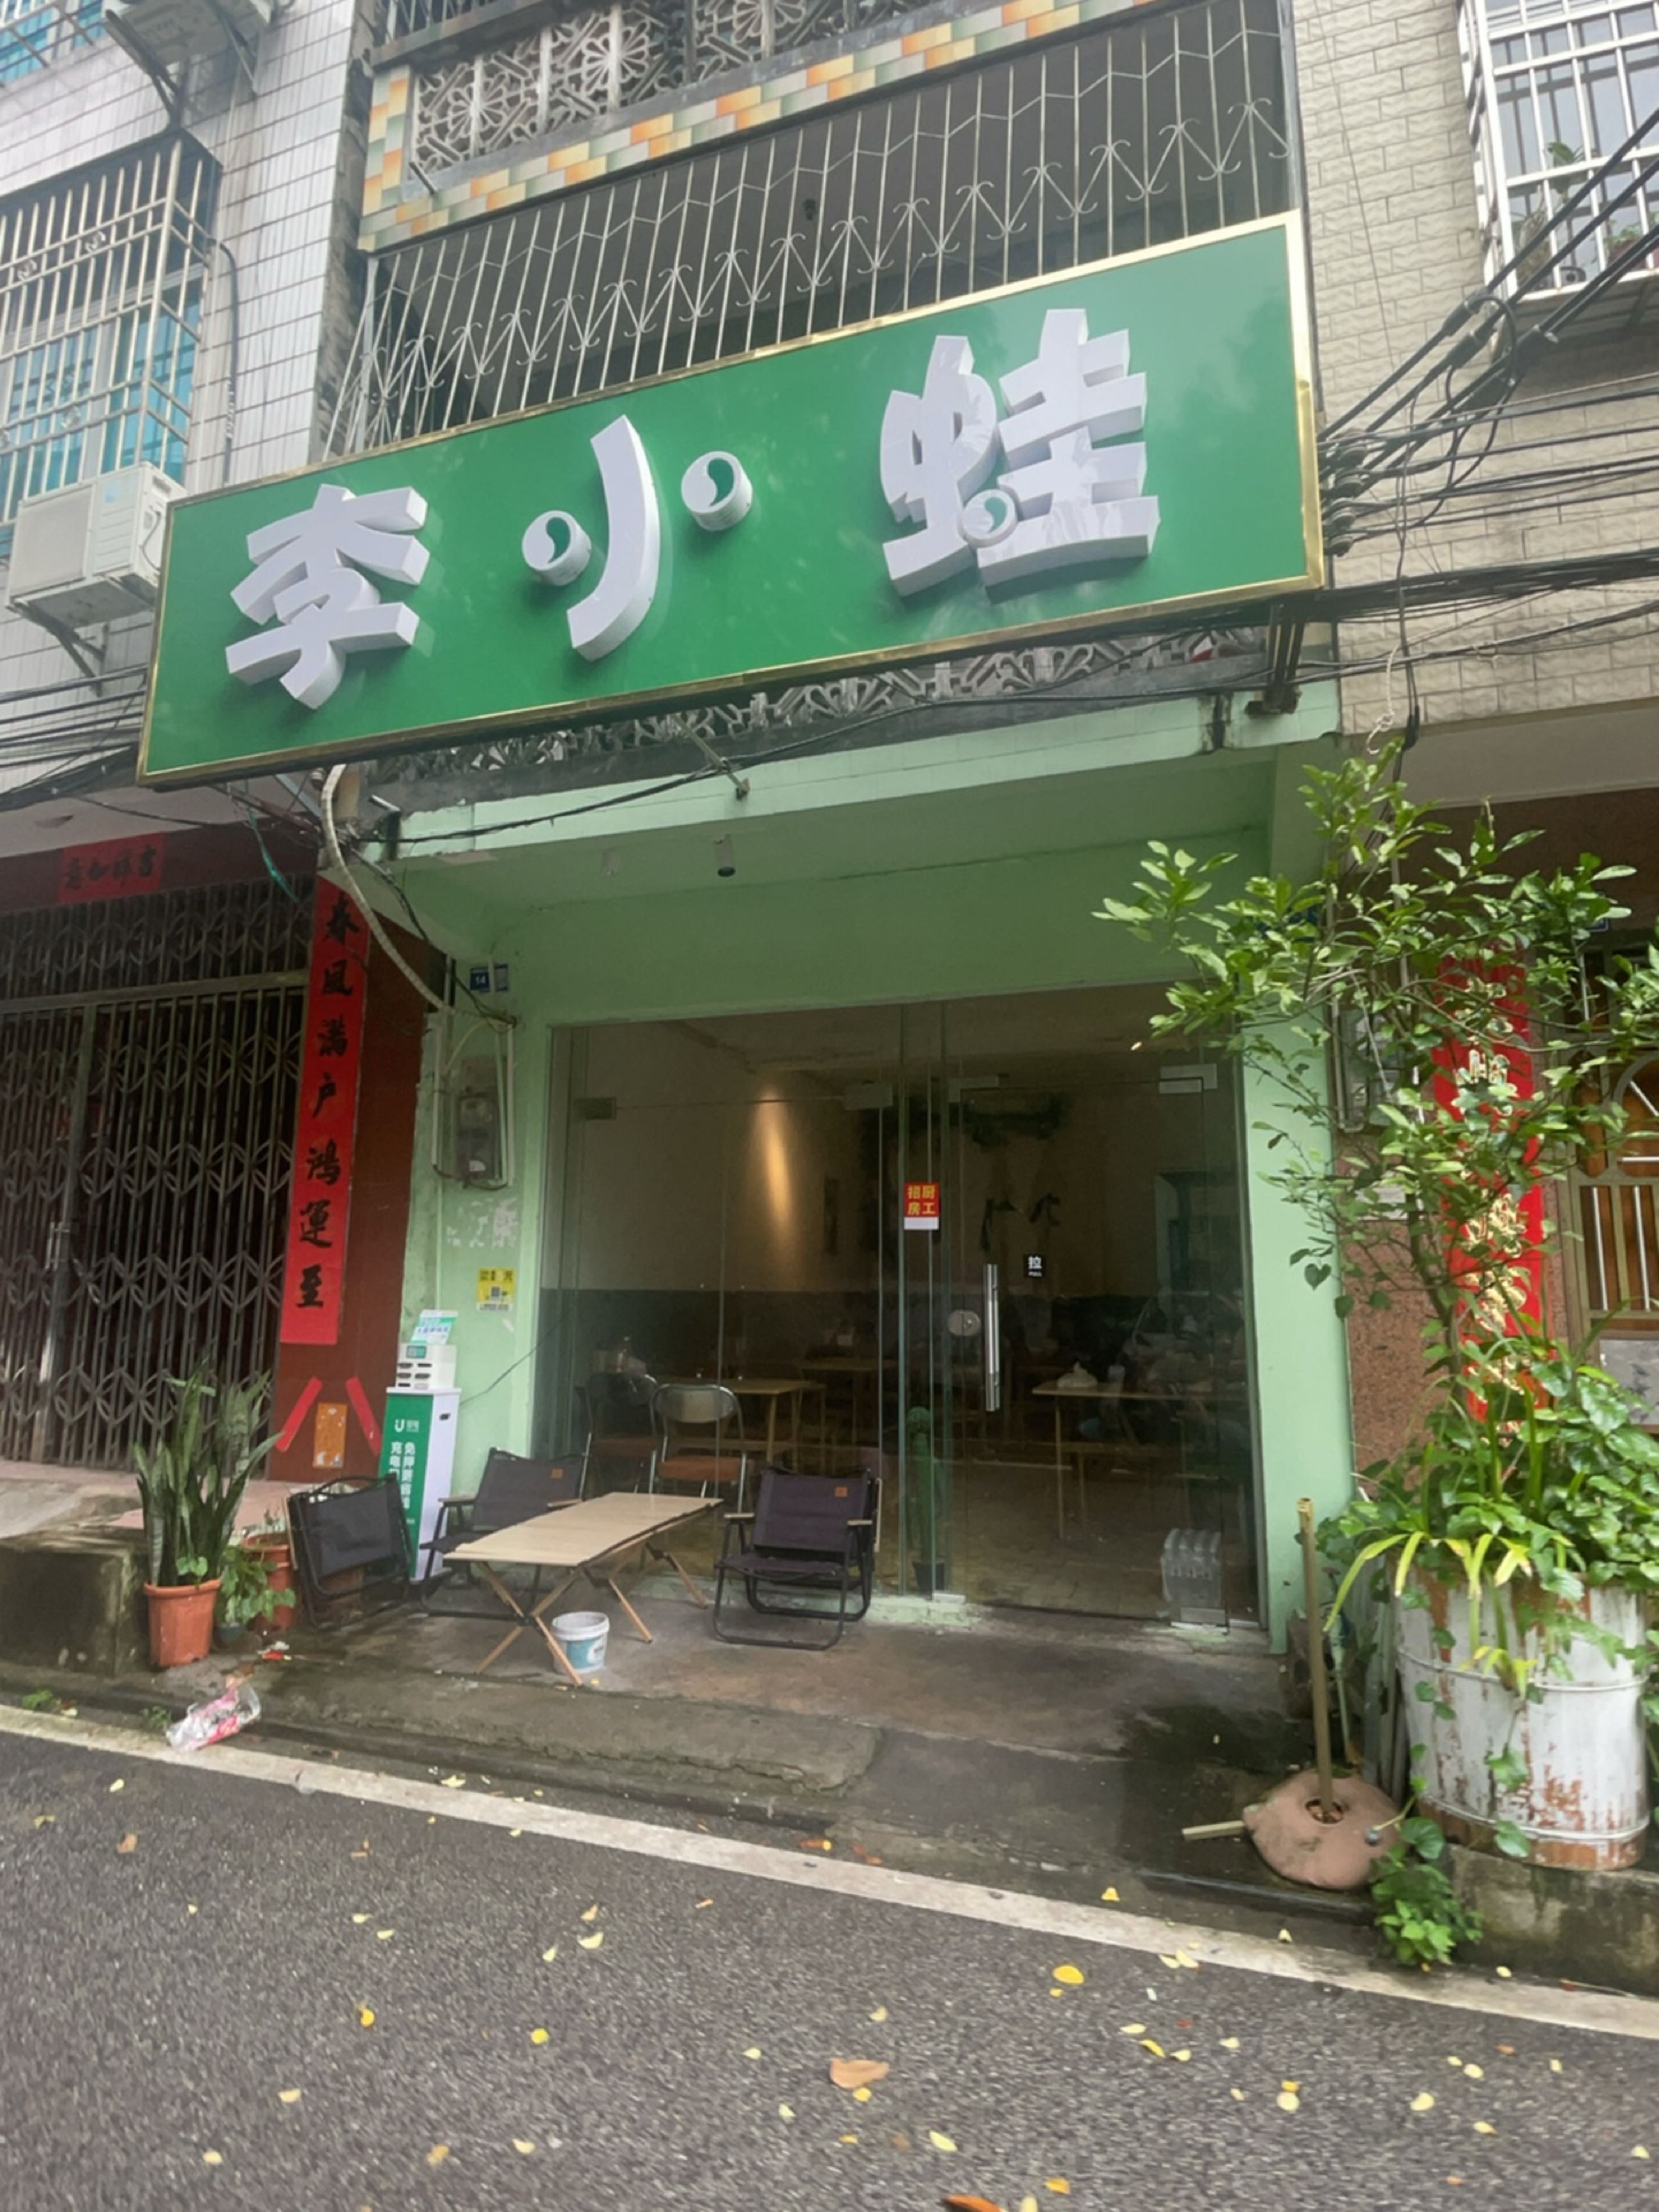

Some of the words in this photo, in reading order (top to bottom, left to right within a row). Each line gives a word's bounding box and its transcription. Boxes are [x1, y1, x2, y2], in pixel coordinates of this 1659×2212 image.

[226, 307, 1160, 709] 李小蛙
[1028, 1255, 1043, 1269] 拉
